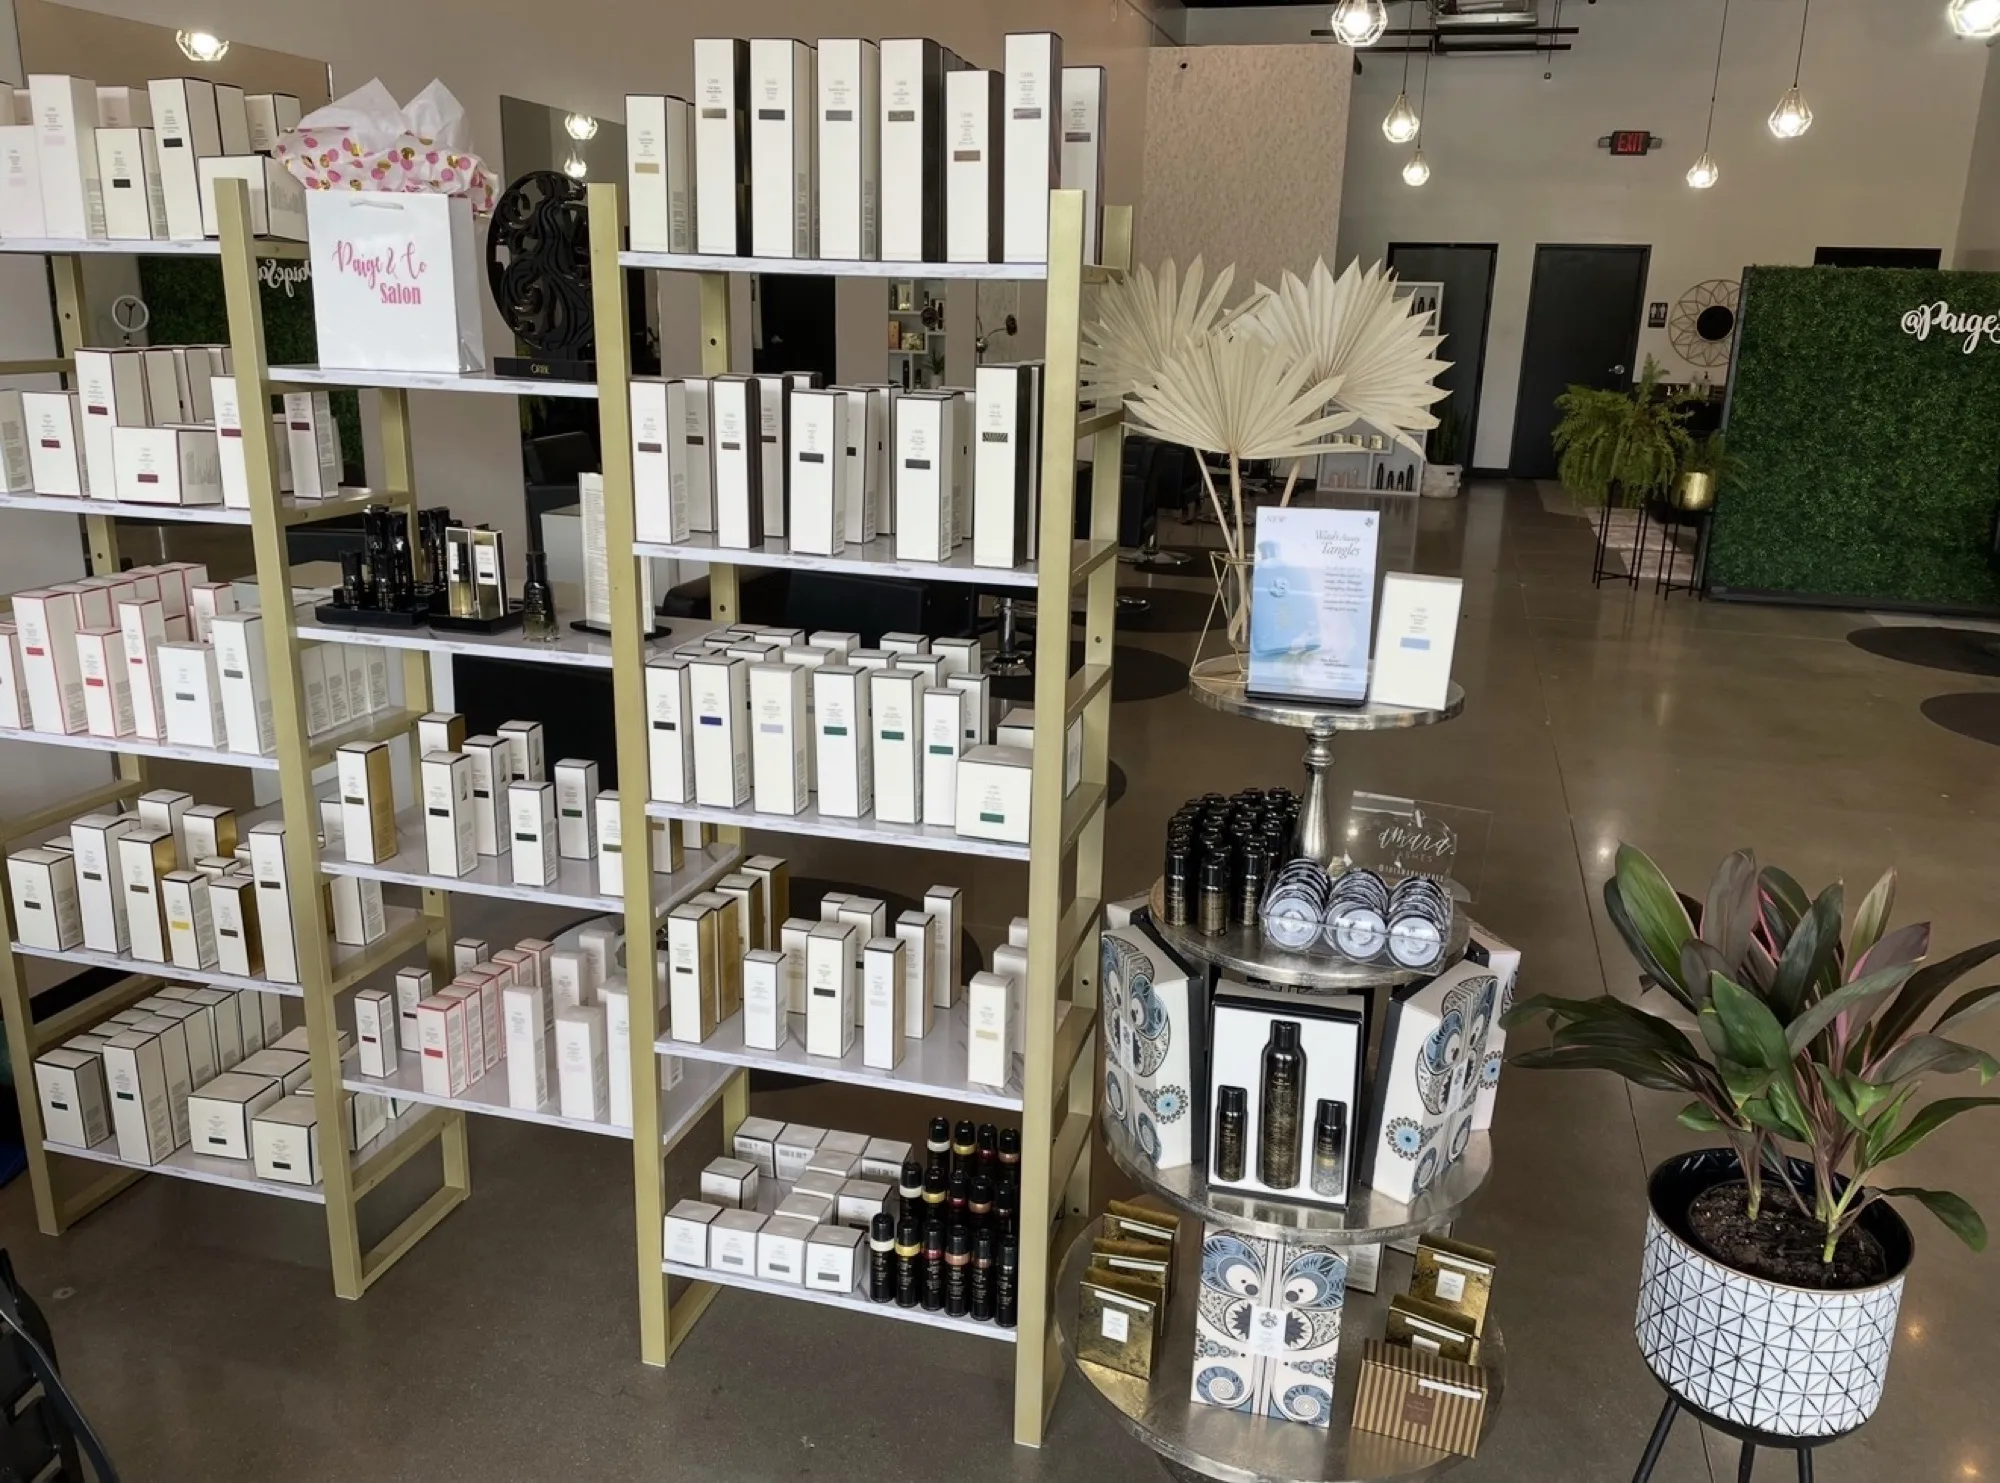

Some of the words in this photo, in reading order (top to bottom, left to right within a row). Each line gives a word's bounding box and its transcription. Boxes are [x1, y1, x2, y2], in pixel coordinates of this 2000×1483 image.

[1617, 132, 1645, 151] EXIT
[332, 240, 382, 290] Paige
[386, 246, 399, 280] &
[380, 282, 422, 305] Salon
[1901, 301, 2000, 354] @Paige
[1322, 542, 1360, 559] Tangles
